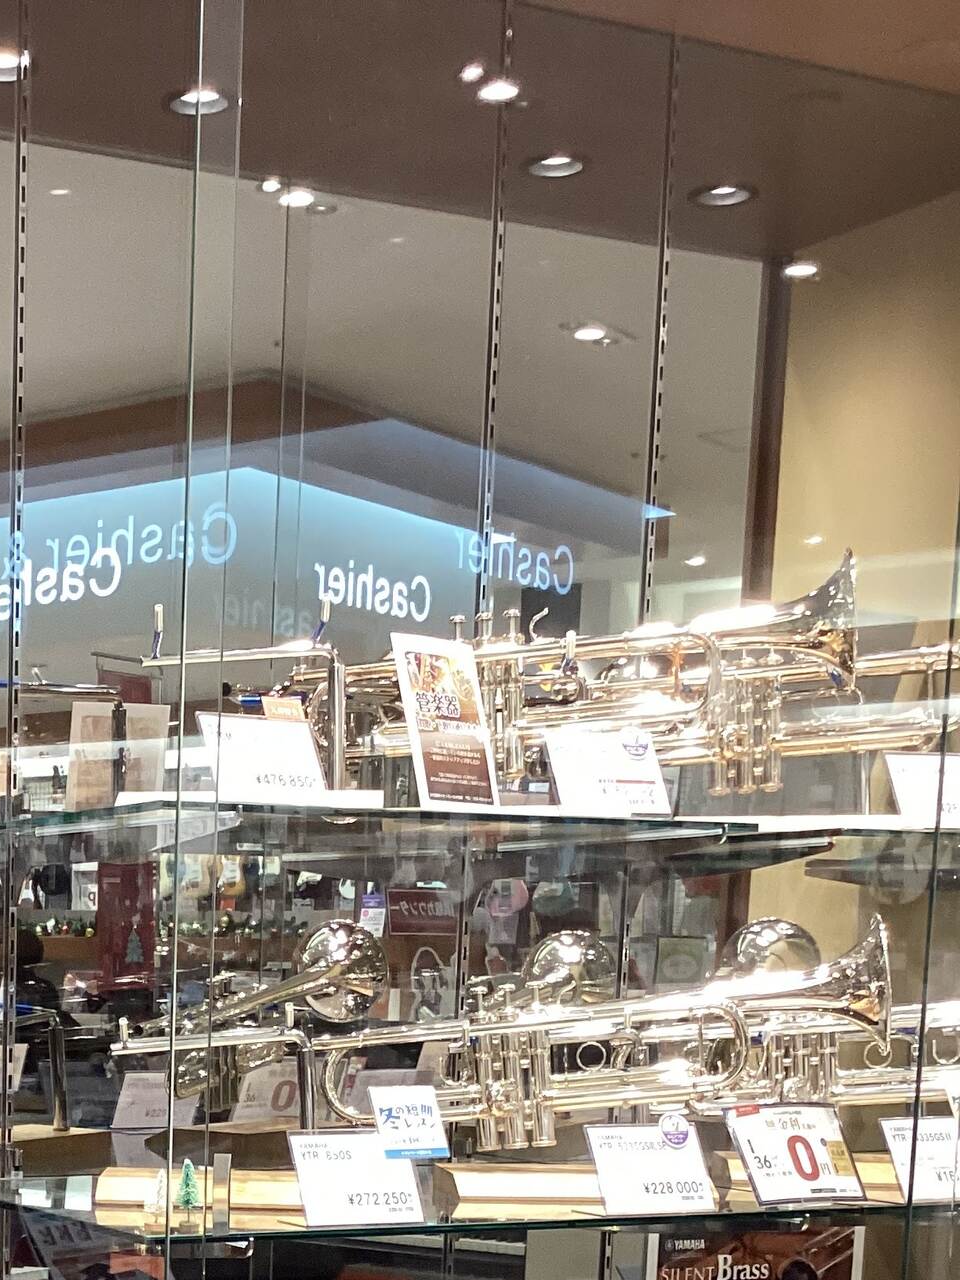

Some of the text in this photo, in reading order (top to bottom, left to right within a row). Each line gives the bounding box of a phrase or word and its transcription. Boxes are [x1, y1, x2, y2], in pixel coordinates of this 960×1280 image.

[416, 692, 460, 718] 管楽器
[754, 1155, 772, 1169] 36
[787, 1134, 821, 1183] 0
[674, 1239, 705, 1250] YAMAHA
